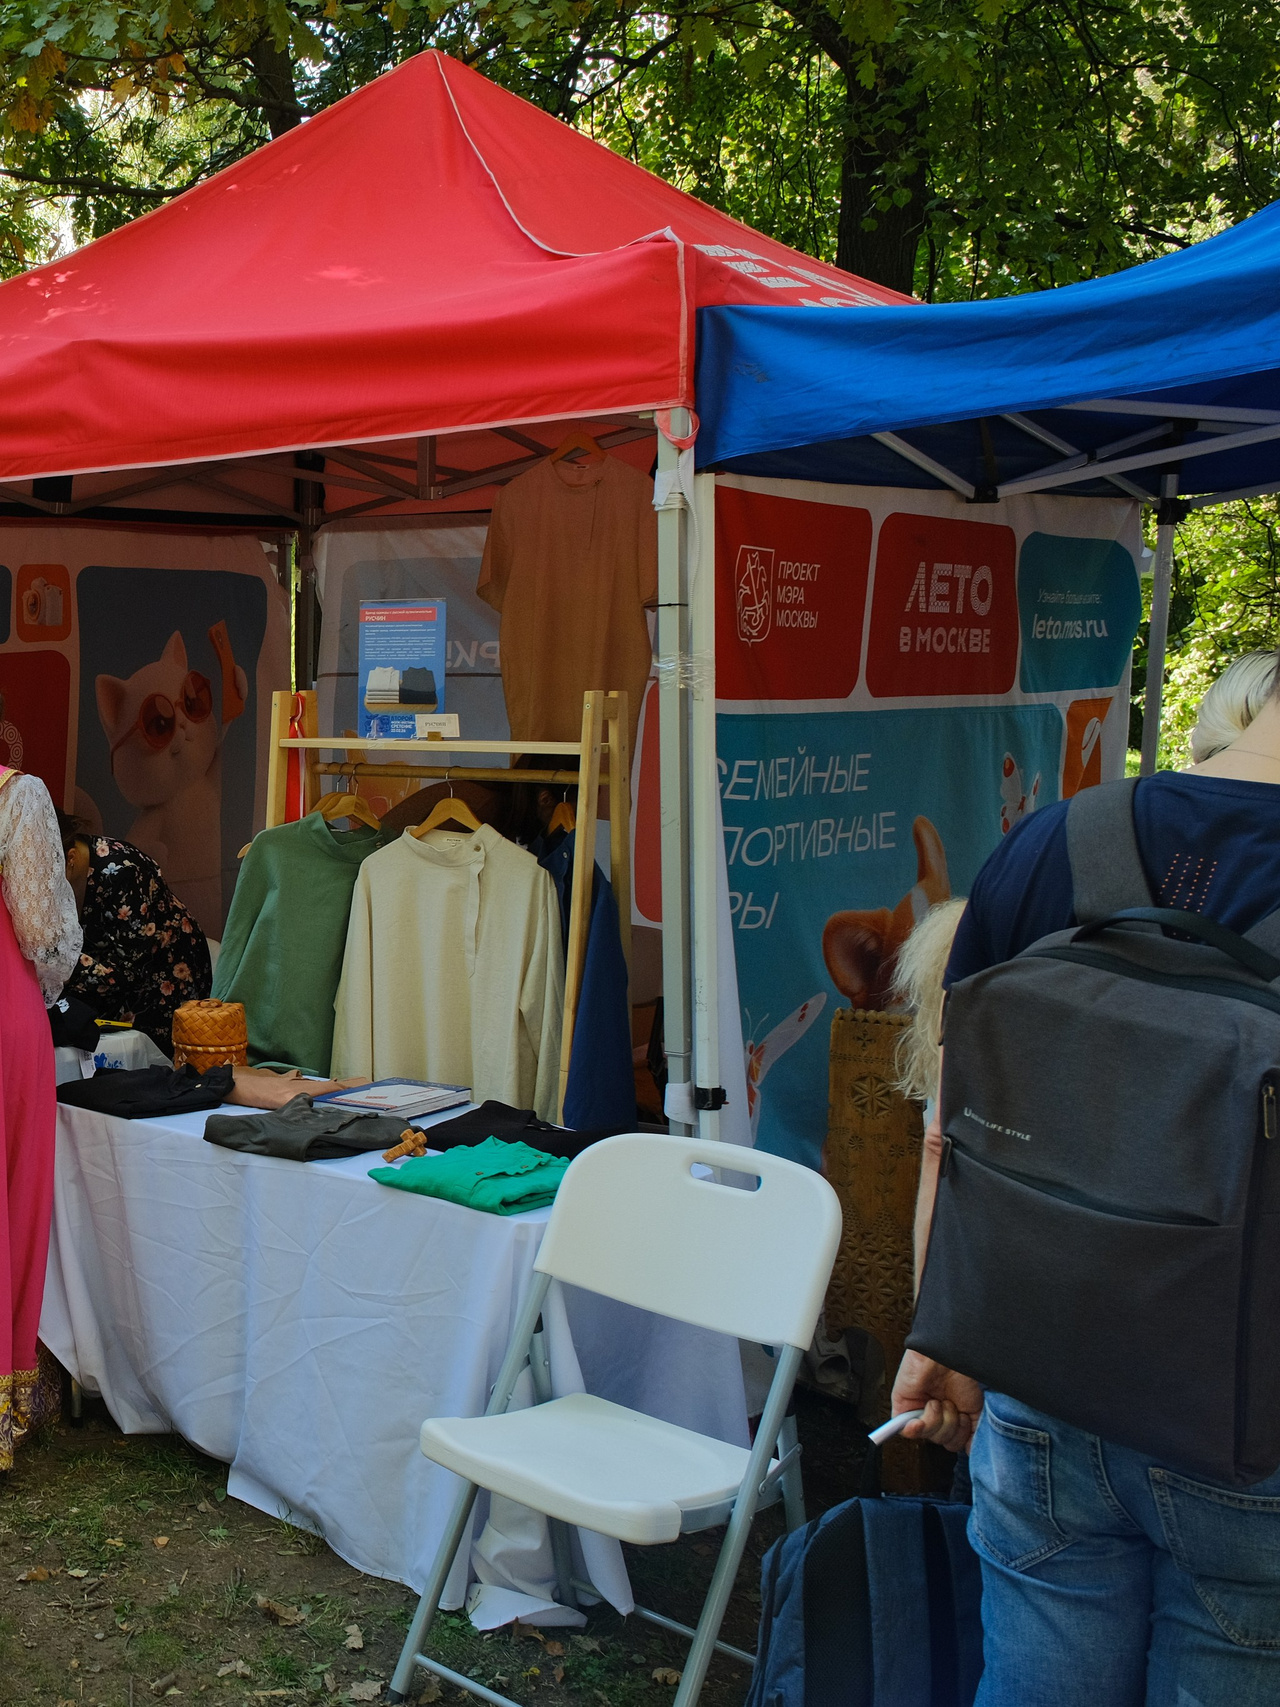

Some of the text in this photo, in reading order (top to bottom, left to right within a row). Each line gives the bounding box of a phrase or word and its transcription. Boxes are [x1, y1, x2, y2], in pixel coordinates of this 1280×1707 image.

[778, 561, 821, 581] ПРОЕКТ
[777, 584, 805, 605] МЭРА
[904, 561, 993, 616] ЛЕТО
[776, 609, 819, 629] МОСКВЫ
[899, 626, 991, 654] В МОСКВЕ
[722, 811, 896, 867] ПОРТИВНЫЕ
[1004, 1128, 1032, 1141] STYLE
